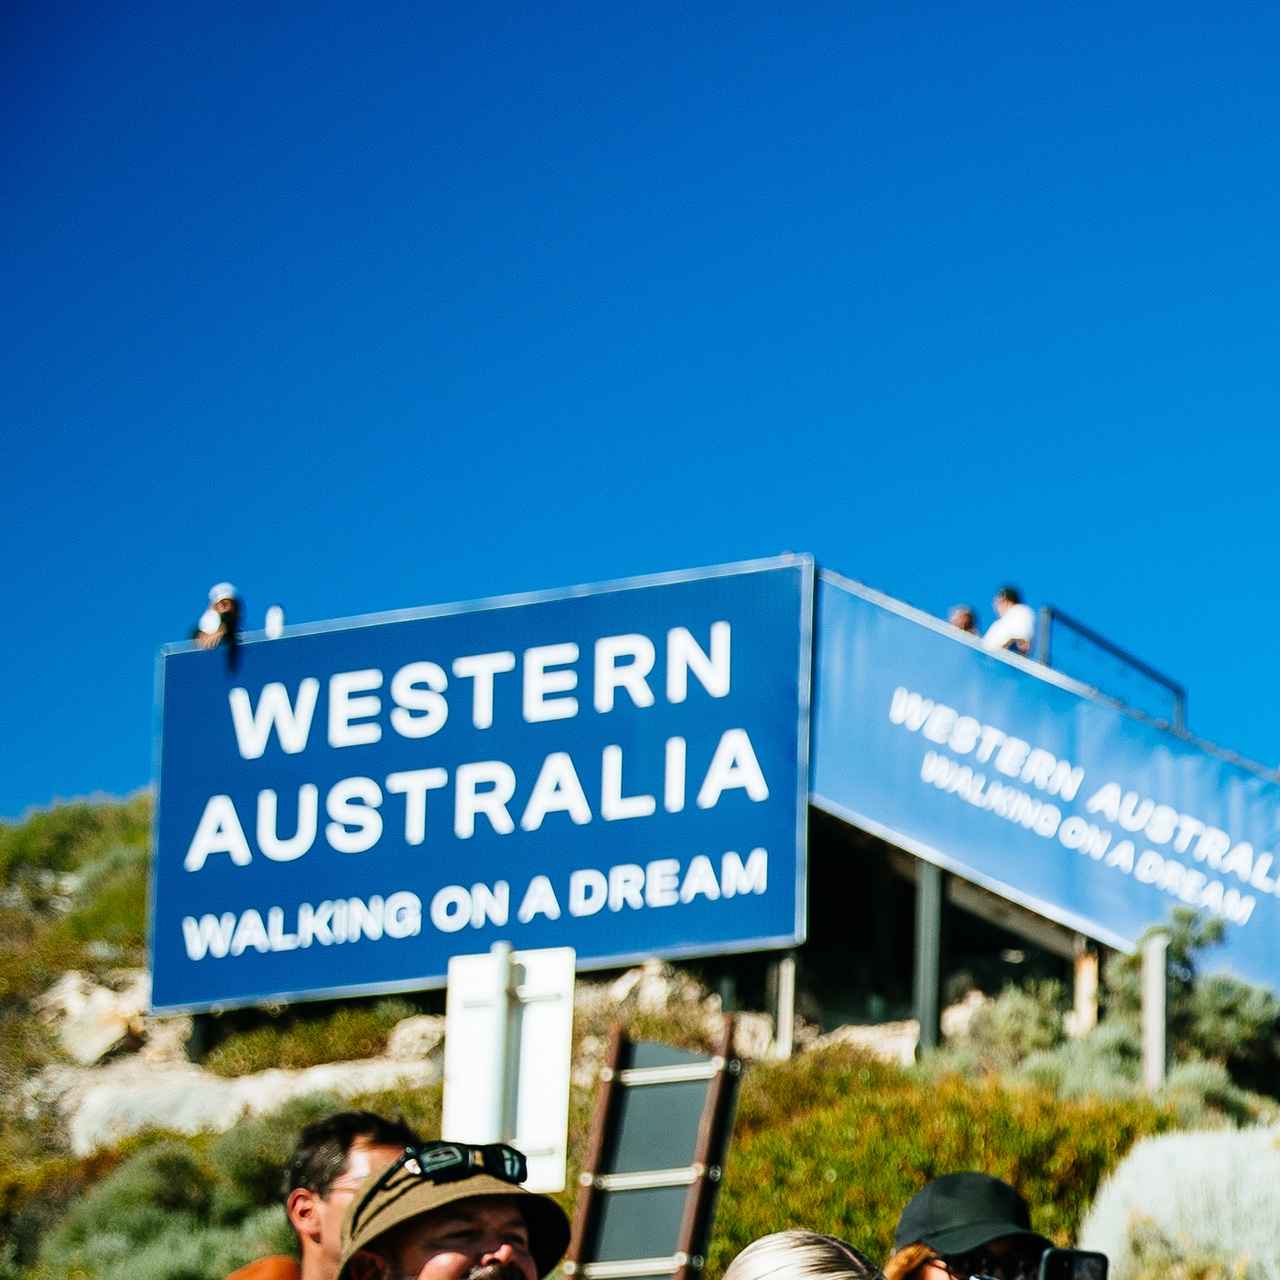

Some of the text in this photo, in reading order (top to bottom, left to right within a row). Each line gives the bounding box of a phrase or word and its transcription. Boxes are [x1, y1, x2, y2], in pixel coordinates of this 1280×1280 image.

[229, 621, 731, 760] WESTERN
[889, 686, 1085, 802] WESTERN
[184, 728, 769, 872] AUSTRALIA
[920, 750, 1256, 926] WALKING ON A DREAM
[182, 848, 768, 961] WALKING ON A DREAM
